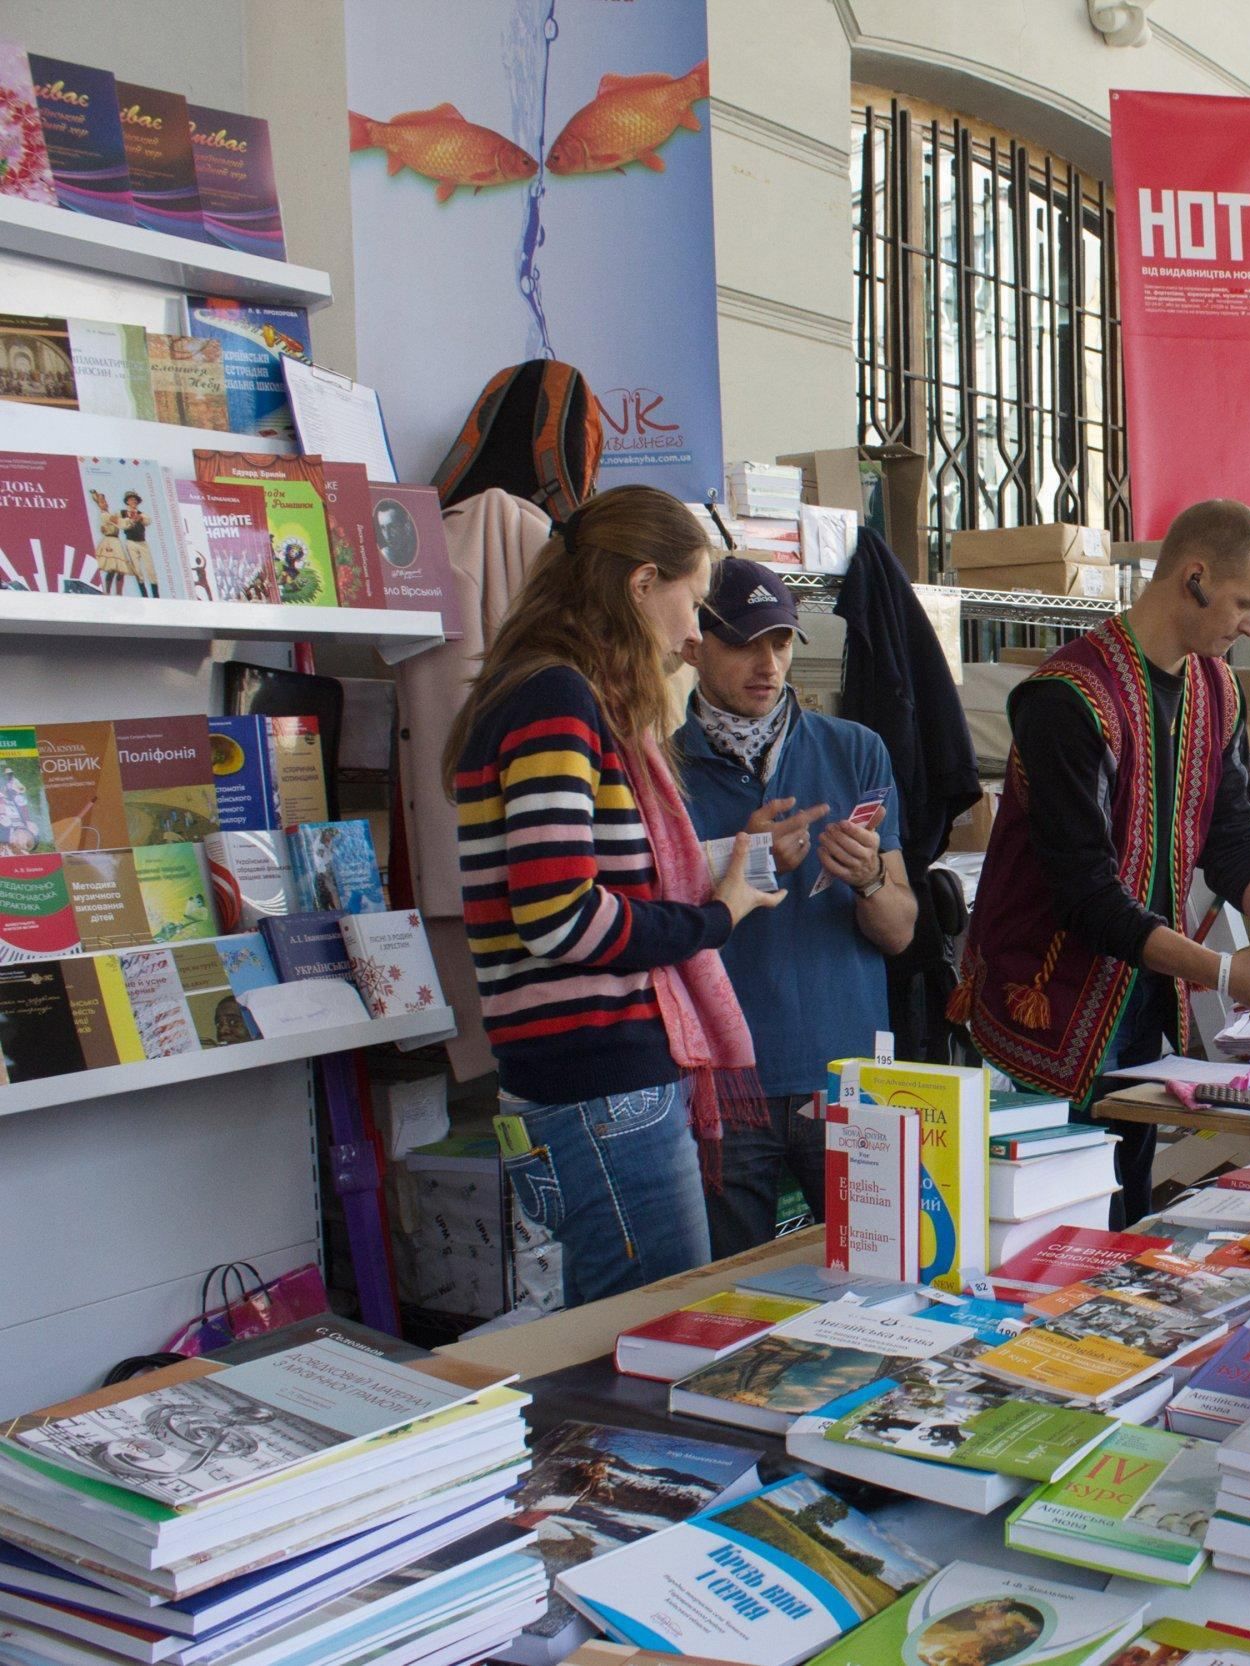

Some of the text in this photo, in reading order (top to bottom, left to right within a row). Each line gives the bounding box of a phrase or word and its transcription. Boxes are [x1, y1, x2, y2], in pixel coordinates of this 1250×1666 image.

[1142, 266, 1158, 277] ВІД
[1160, 267, 1231, 280] ВИДАВНИЦТВА
[224, 351, 270, 364] КРАЇНСЬКА
[747, 596, 778, 604] adidas
[118, 746, 197, 764] Поліфонія
[40, 756, 102, 774] ОВНИК
[72, 881, 117, 891] Методика
[74, 892, 121, 903] музичного
[75, 903, 124, 912] виховання
[91, 913, 114, 923] дітей
[304, 933, 343, 942] Іваницьк
[294, 961, 350, 976] УКРАЇНСЬКИ
[876, 1055, 892, 1065] 195
[887, 1079, 917, 1088] Advanced
[918, 1081, 946, 1090] Learners
[844, 1087, 855, 1097] 33
[838, 1136, 891, 1153] DICTIONARY
[850, 1157, 879, 1166] Beginners
[1231, 1180, 1238, 1188] N.
[840, 1188, 892, 1208] Ukrainian
[840, 1236, 878, 1252] English
[933, 1279, 955, 1290] NEW
[974, 1282, 989, 1292] 82
[316, 1327, 327, 1335] С.
[814, 1317, 894, 1341] Англійська
[898, 1333, 935, 1348] мова
[1200, 1402, 1231, 1415] мова
[1084, 1453, 1151, 1486] IV
[1063, 1481, 1134, 1505] курс
[1038, 1503, 1115, 1528] Англійська
[1051, 1516, 1087, 1531] мова
